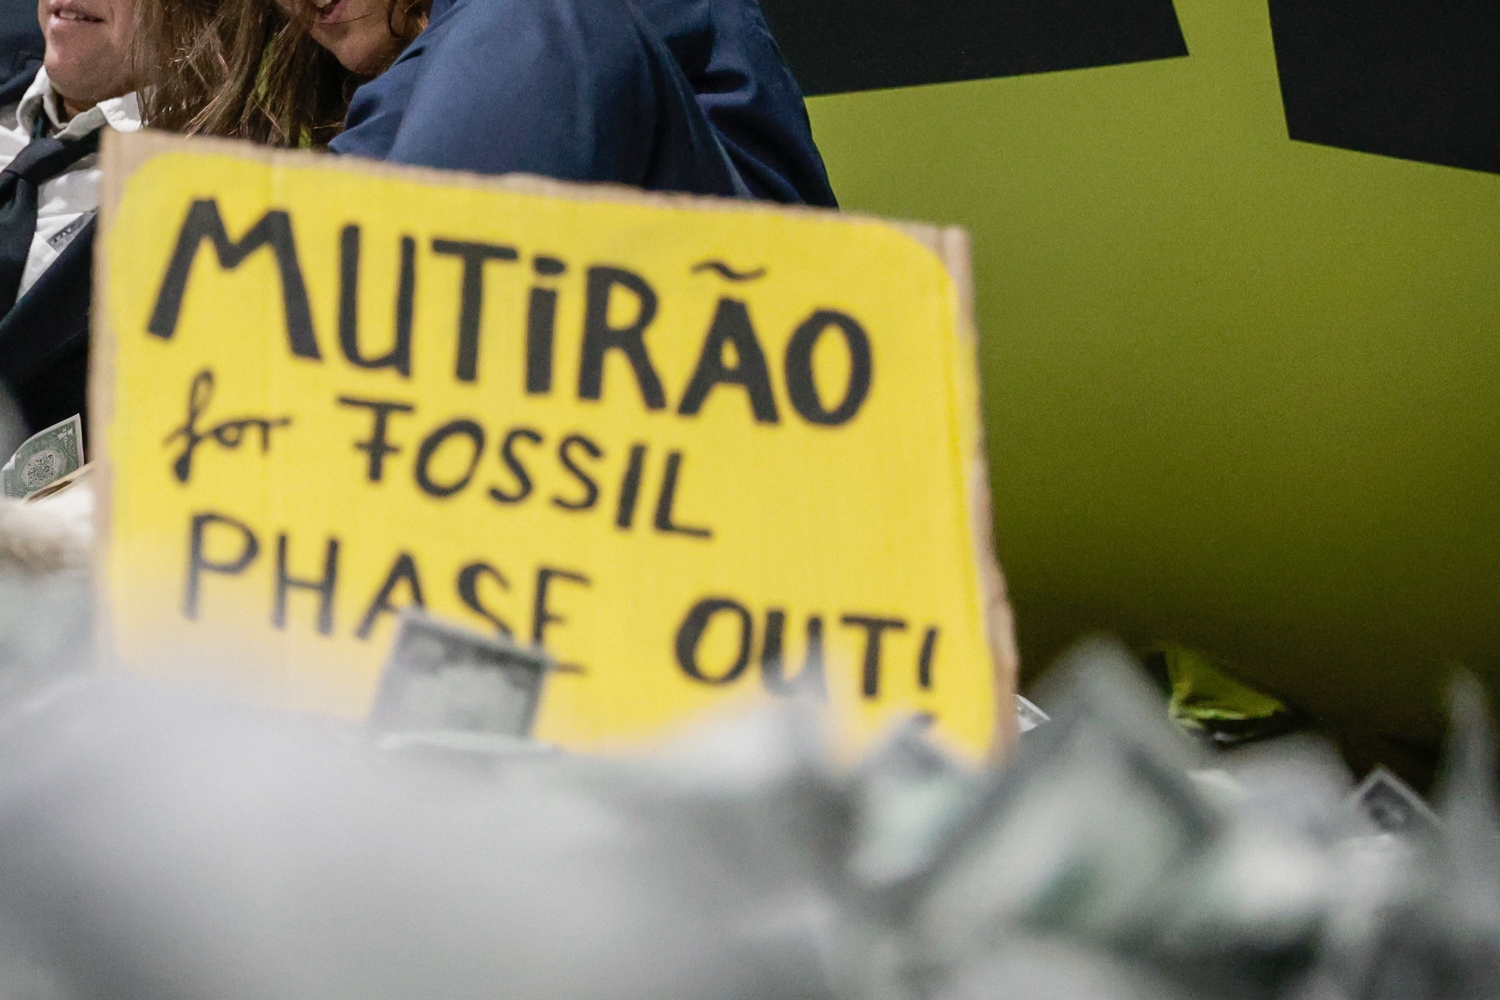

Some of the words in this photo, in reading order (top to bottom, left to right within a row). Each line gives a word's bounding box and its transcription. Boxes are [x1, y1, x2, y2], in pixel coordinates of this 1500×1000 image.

[163, 368, 291, 482] for
[335, 396, 713, 539] FOSSIL
[182, 511, 592, 675] PHASE
[674, 594, 938, 728] OUT!
